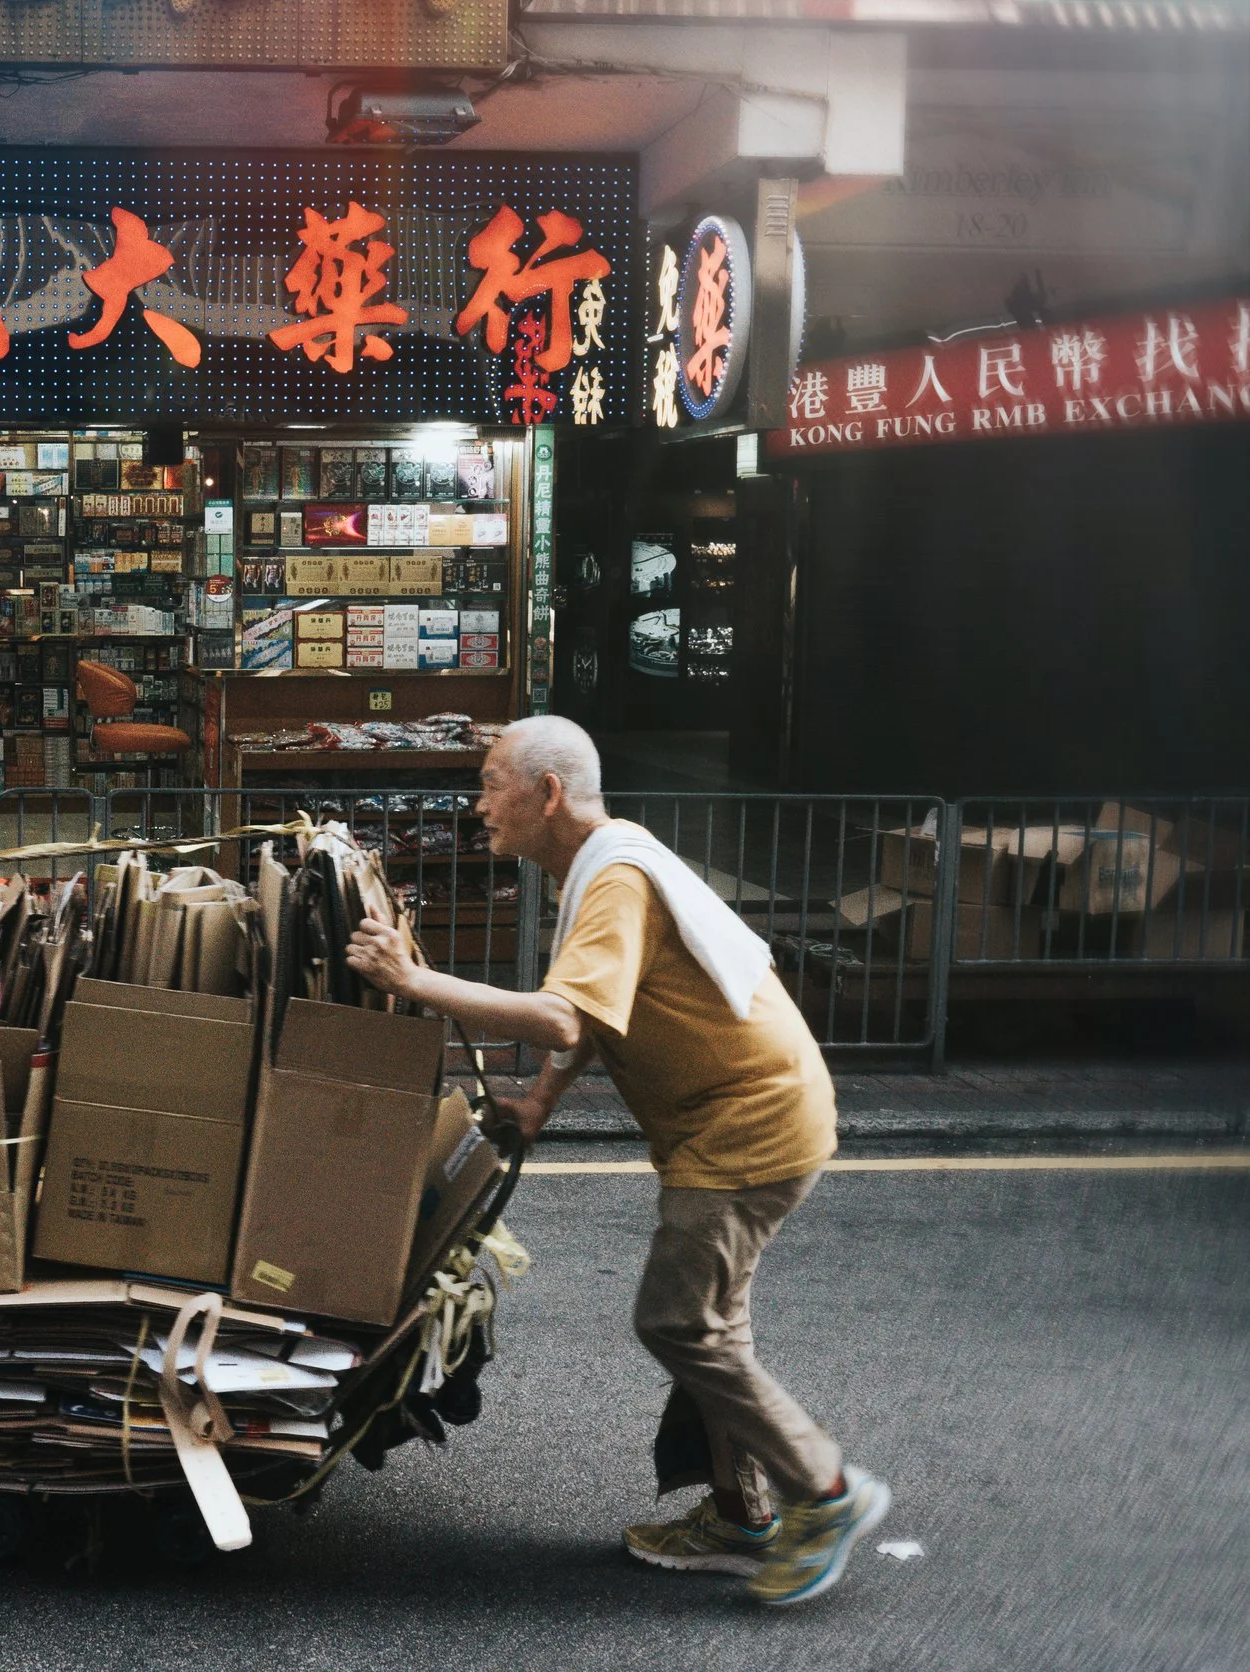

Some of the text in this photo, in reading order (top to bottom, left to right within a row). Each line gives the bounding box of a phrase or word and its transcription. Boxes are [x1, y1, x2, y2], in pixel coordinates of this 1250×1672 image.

[790, 418, 863, 448] KONG
[876, 411, 956, 439] FUNG
[972, 402, 1046, 431] RMB
